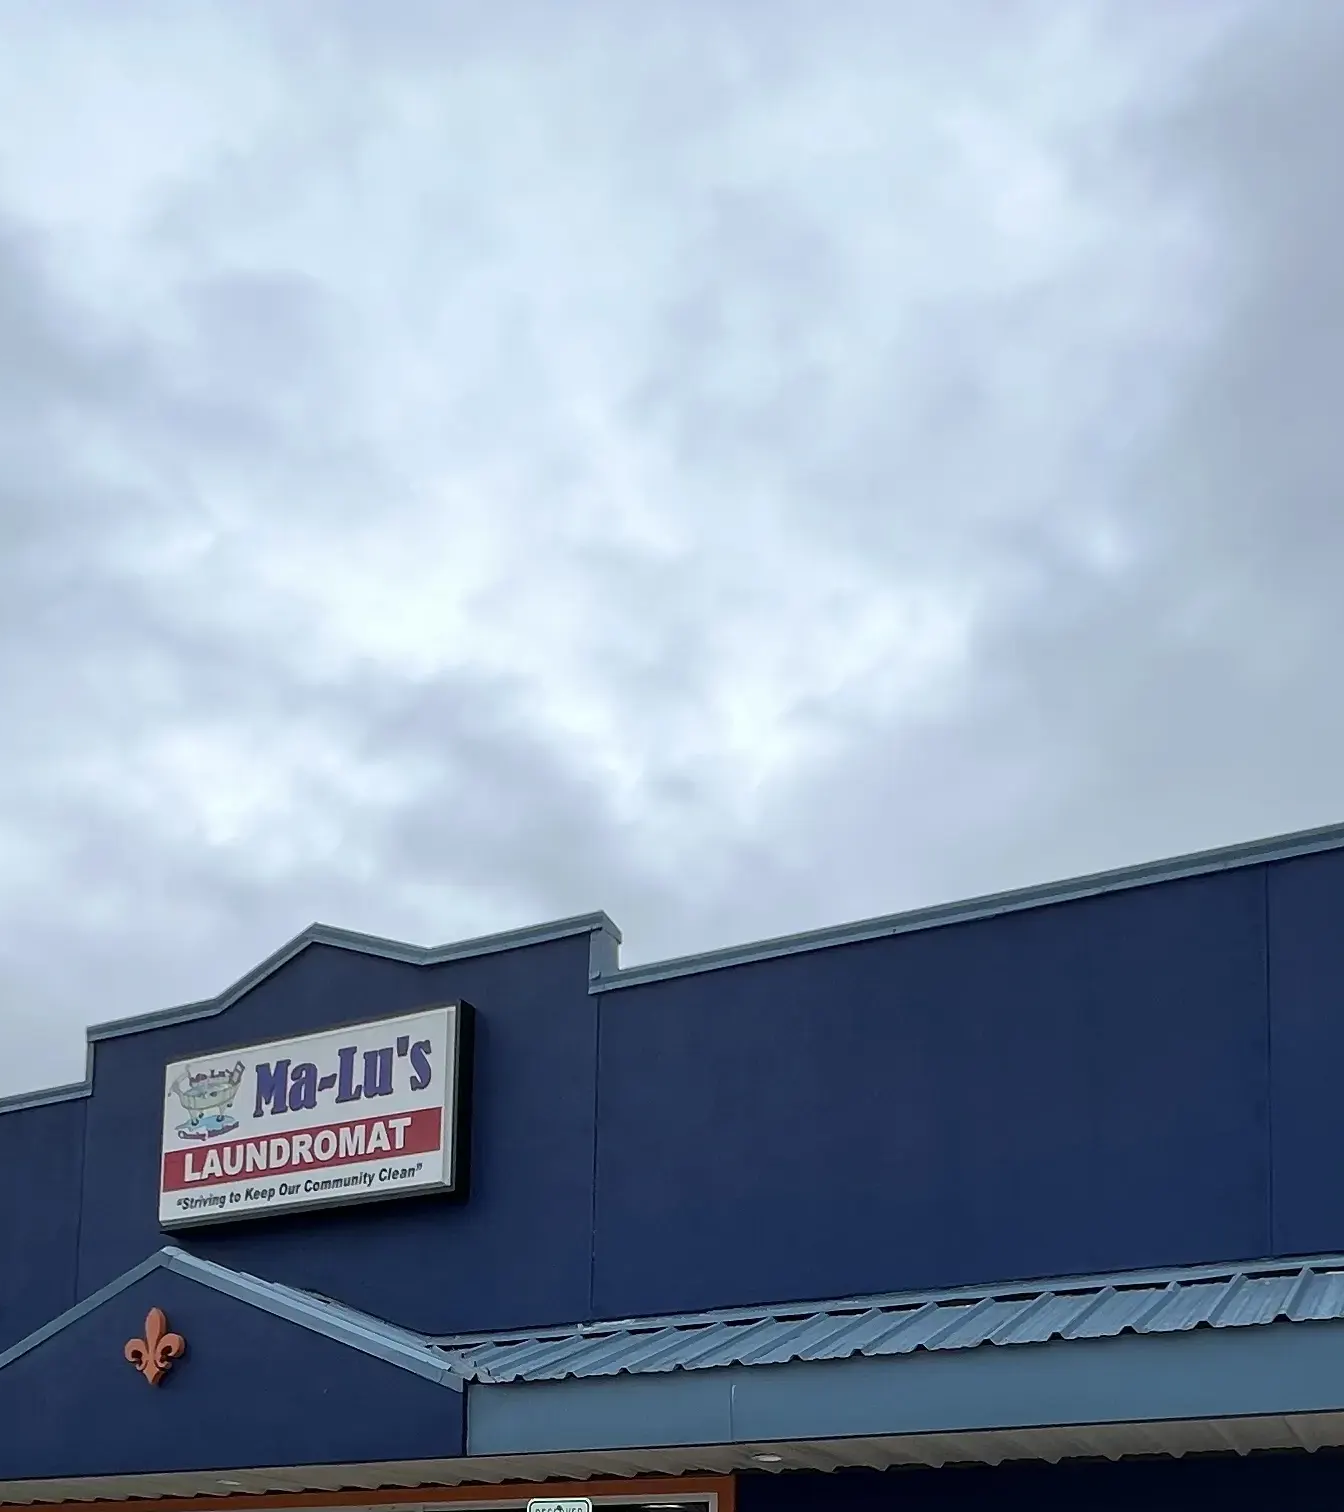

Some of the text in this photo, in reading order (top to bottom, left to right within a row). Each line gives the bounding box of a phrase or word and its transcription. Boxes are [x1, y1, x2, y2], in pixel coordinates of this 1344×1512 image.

[252, 1035, 432, 1118] Ma-Lu's
[184, 1116, 412, 1182] LAUNDROMAT
[229, 1190, 242, 1204] to
[244, 1186, 276, 1202] Keep
[279, 1182, 301, 1197] Our
[304, 1171, 376, 1194] Community
